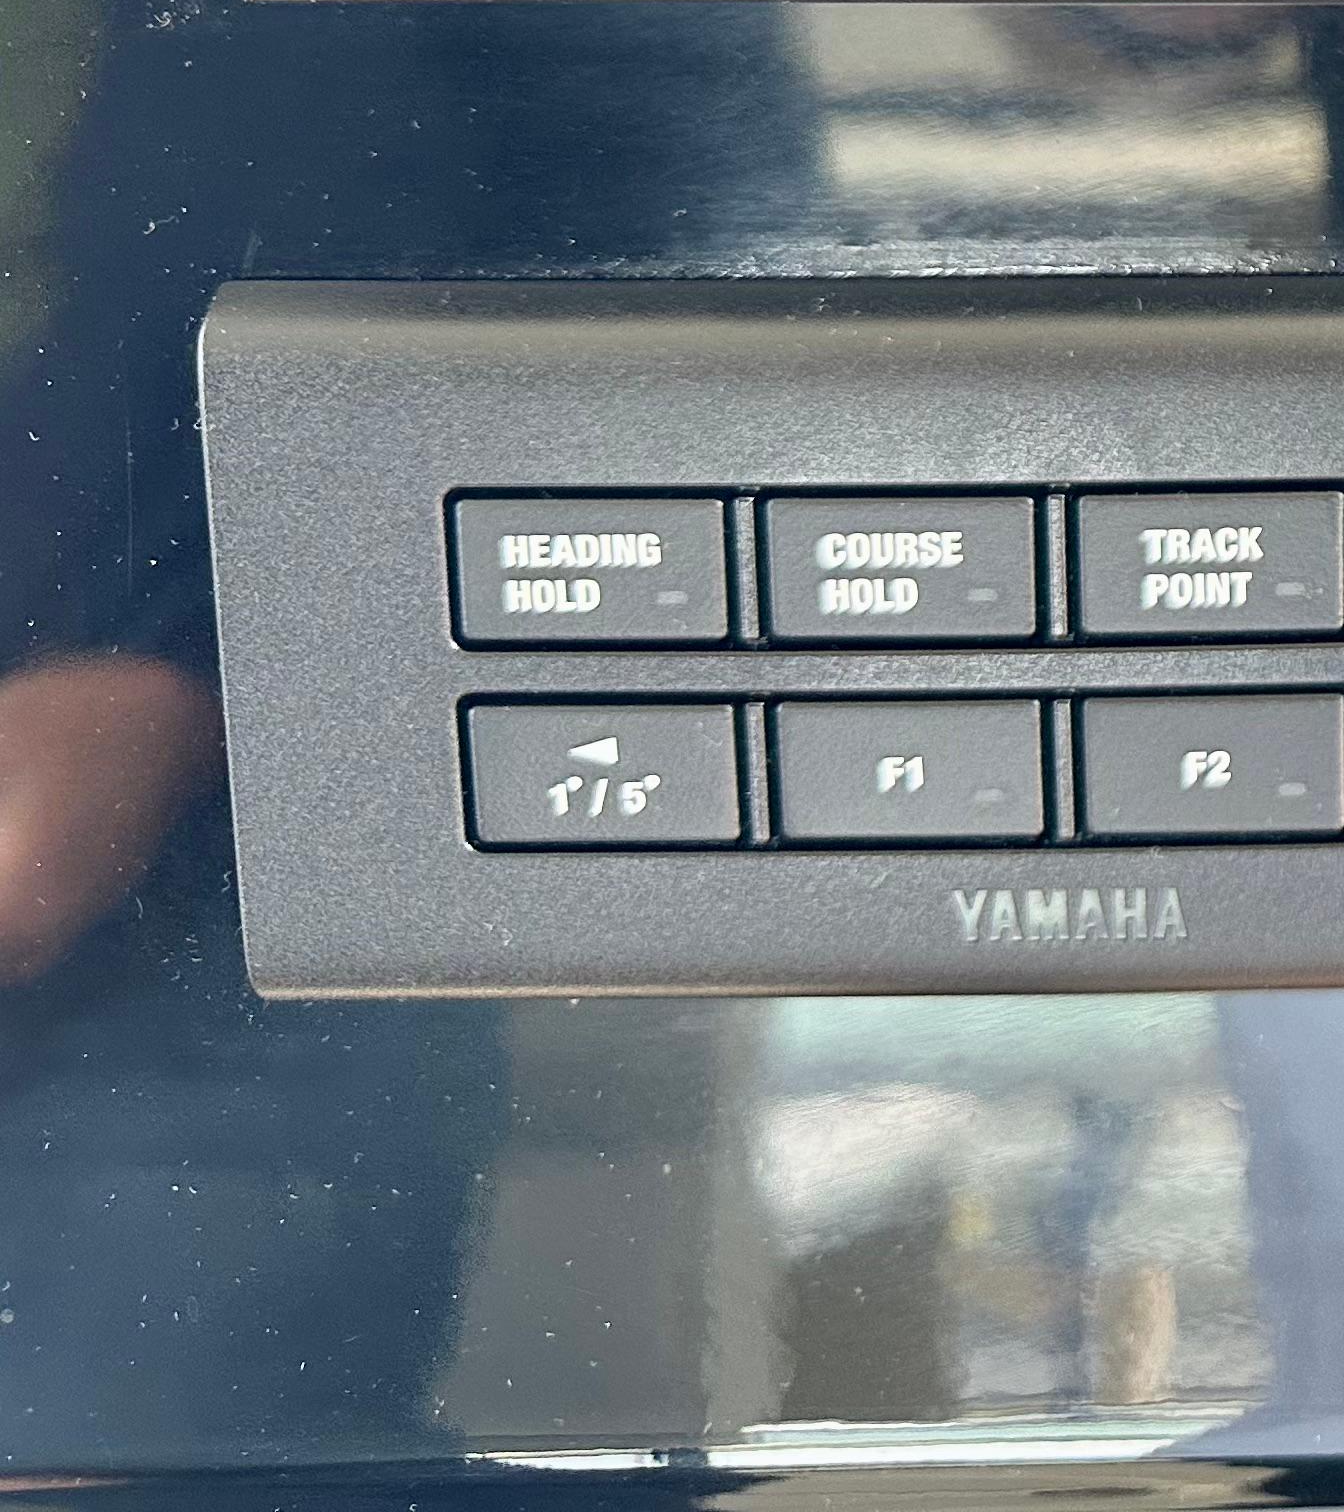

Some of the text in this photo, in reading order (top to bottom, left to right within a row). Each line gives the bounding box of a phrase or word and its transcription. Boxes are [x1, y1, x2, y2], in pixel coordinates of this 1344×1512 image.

[500, 532, 663, 570] HEADING
[816, 529, 963, 570] COURSE
[1139, 526, 1264, 565] TRACK
[501, 575, 601, 614] HOLD
[819, 575, 919, 615] HOLD
[1141, 570, 1253, 610] POINT
[876, 757, 925, 794] F1
[1180, 752, 1232, 790] F2
[951, 887, 1189, 943] YAMAHA
